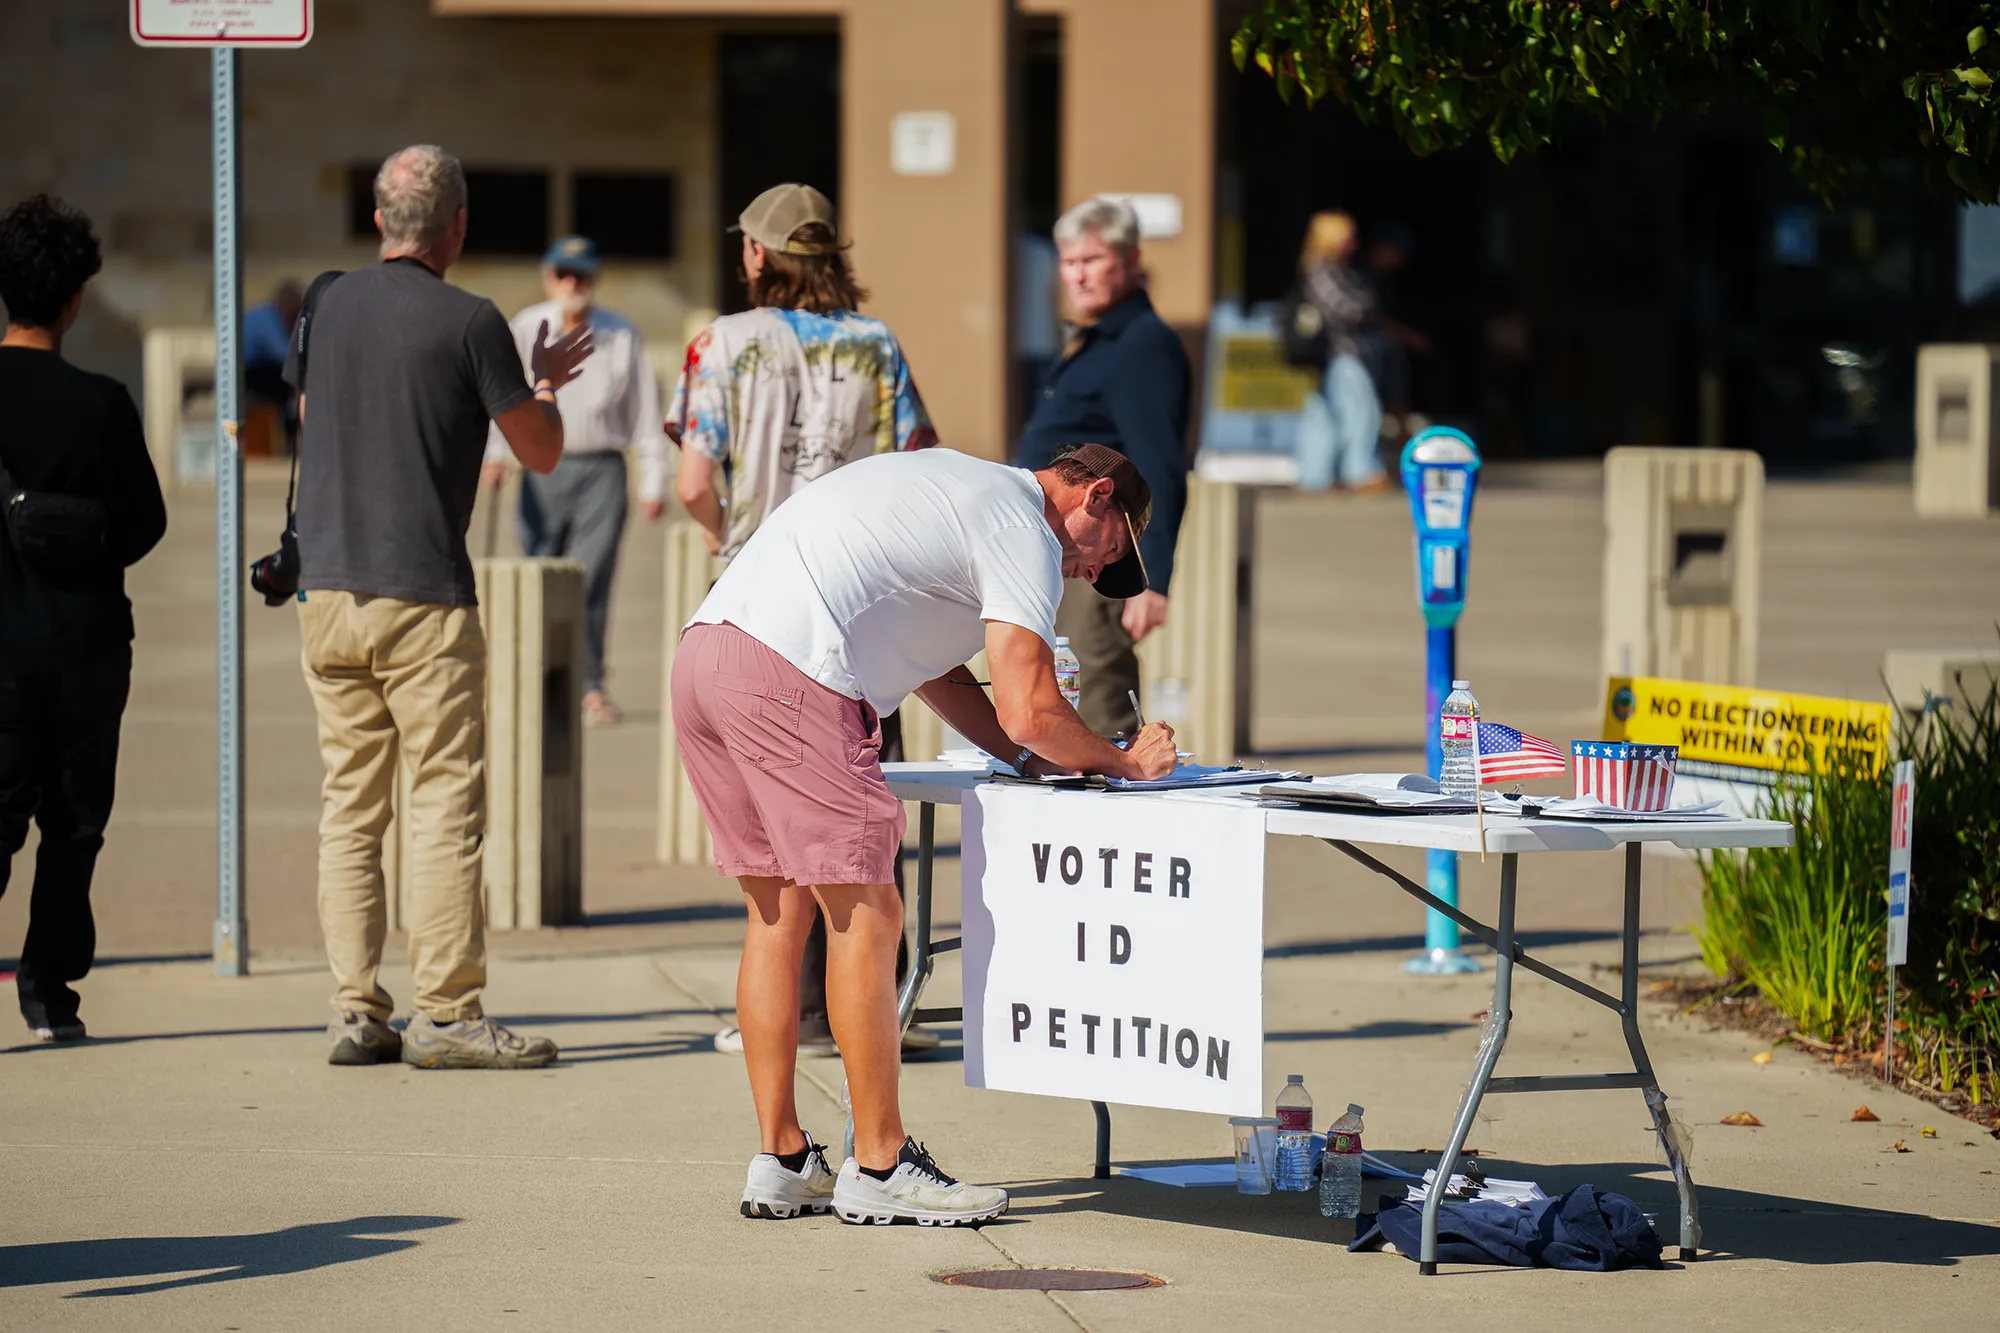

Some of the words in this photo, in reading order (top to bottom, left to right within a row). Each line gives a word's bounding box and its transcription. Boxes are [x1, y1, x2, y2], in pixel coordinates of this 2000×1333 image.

[1650, 697, 1681, 717] NO
[1689, 700, 1877, 742] ELECTIONEERING
[1681, 726, 1764, 755] WITHIN
[1032, 842, 1192, 898] VOTER
[1077, 921, 1132, 965] ID
[1011, 1002, 1230, 1081] PETITION
